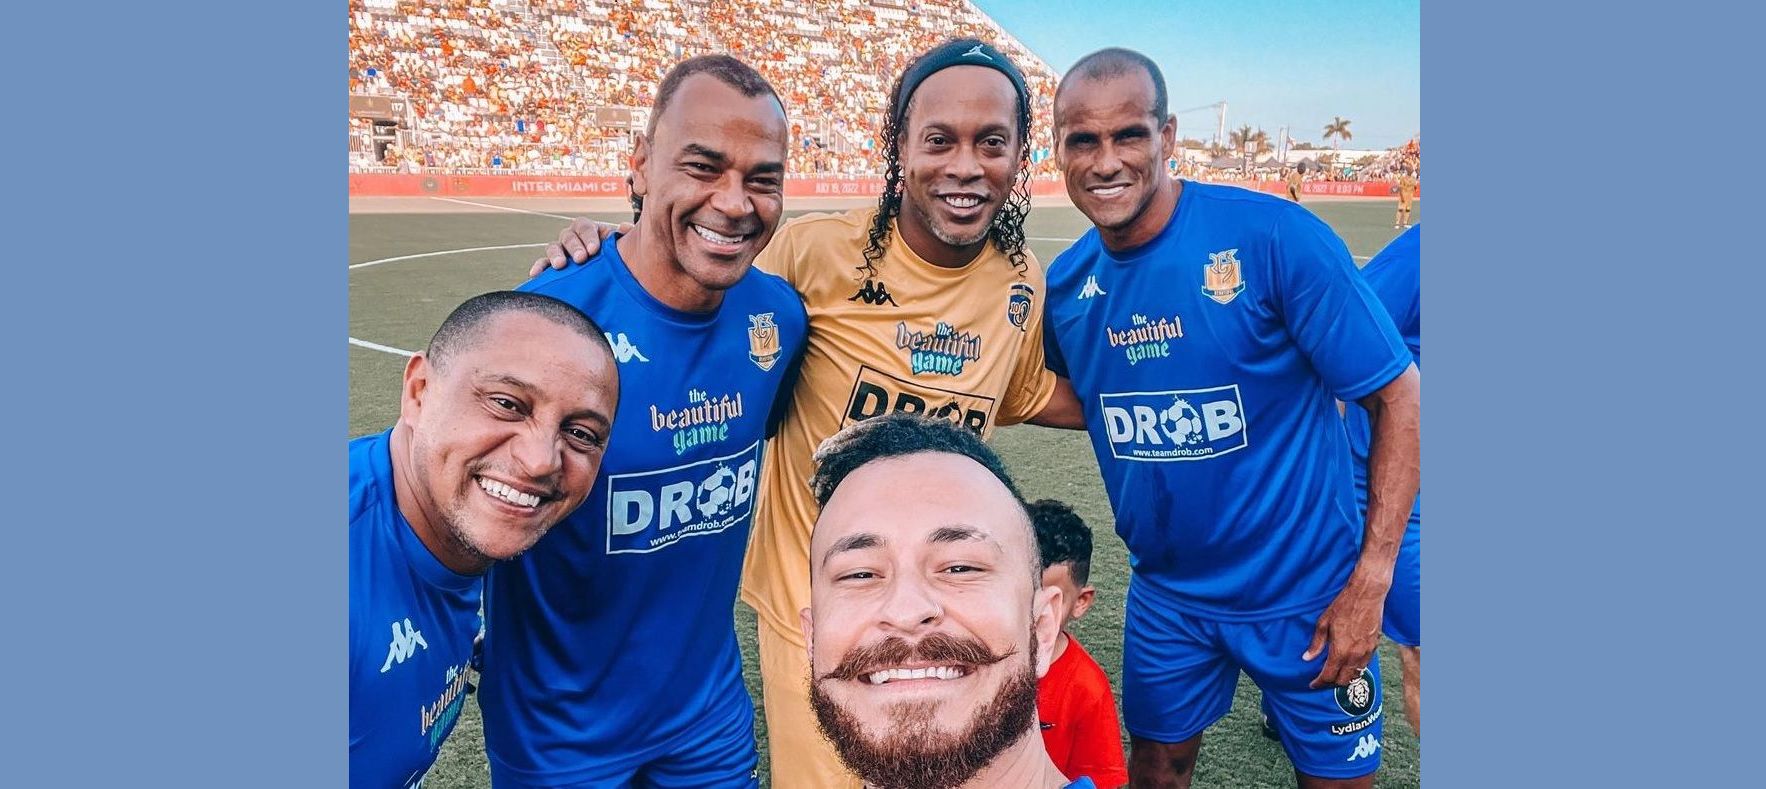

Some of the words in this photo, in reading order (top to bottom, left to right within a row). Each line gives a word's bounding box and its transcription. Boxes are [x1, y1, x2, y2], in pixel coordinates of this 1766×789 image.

[512, 180, 552, 193] INTER
[556, 181, 598, 193] MIAMI
[601, 181, 618, 193] CF
[937, 322, 953, 336] the
[1132, 313, 1147, 326] the
[897, 321, 981, 362] beautiful
[1106, 315, 1184, 348] beautiful
[912, 350, 963, 376] game
[1125, 341, 1170, 366] game
[688, 388, 707, 403] the
[650, 391, 743, 432] beautiful
[673, 422, 729, 456] game
[1133, 446, 1213, 457] www.teamdrob.com
[446, 664, 459, 685] the
